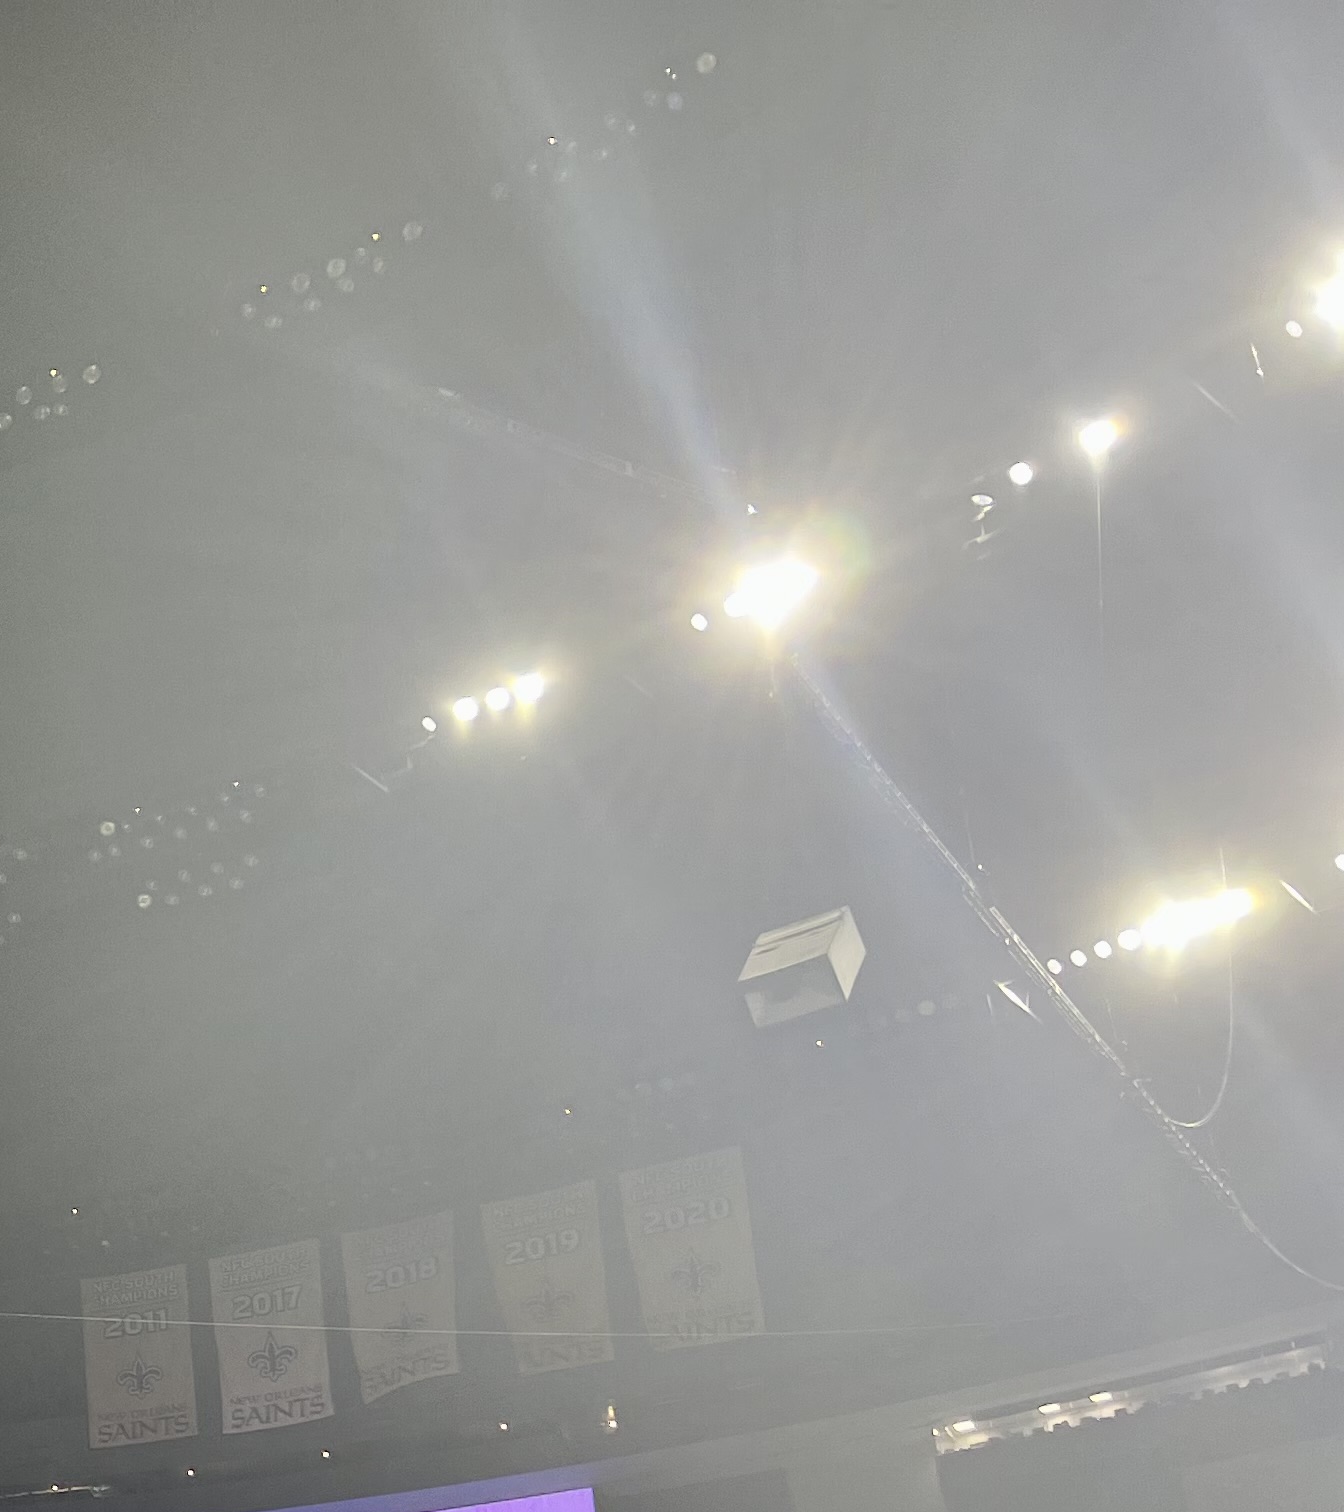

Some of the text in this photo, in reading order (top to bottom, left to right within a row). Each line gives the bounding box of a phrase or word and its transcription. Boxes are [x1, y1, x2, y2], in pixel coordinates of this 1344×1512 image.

[641, 1196, 732, 1236] 2020
[504, 1229, 580, 1265] 2019
[95, 1272, 176, 1293] NFC SOUTH
[222, 1261, 310, 1285] CHAMPIONS
[365, 1256, 439, 1293] 2018
[96, 1285, 178, 1305] CHAMPIONS
[232, 1284, 303, 1320] 2017
[104, 1308, 169, 1339] 2011
[231, 1396, 325, 1429] SAINTS
[98, 1414, 190, 1444] SAINTS
